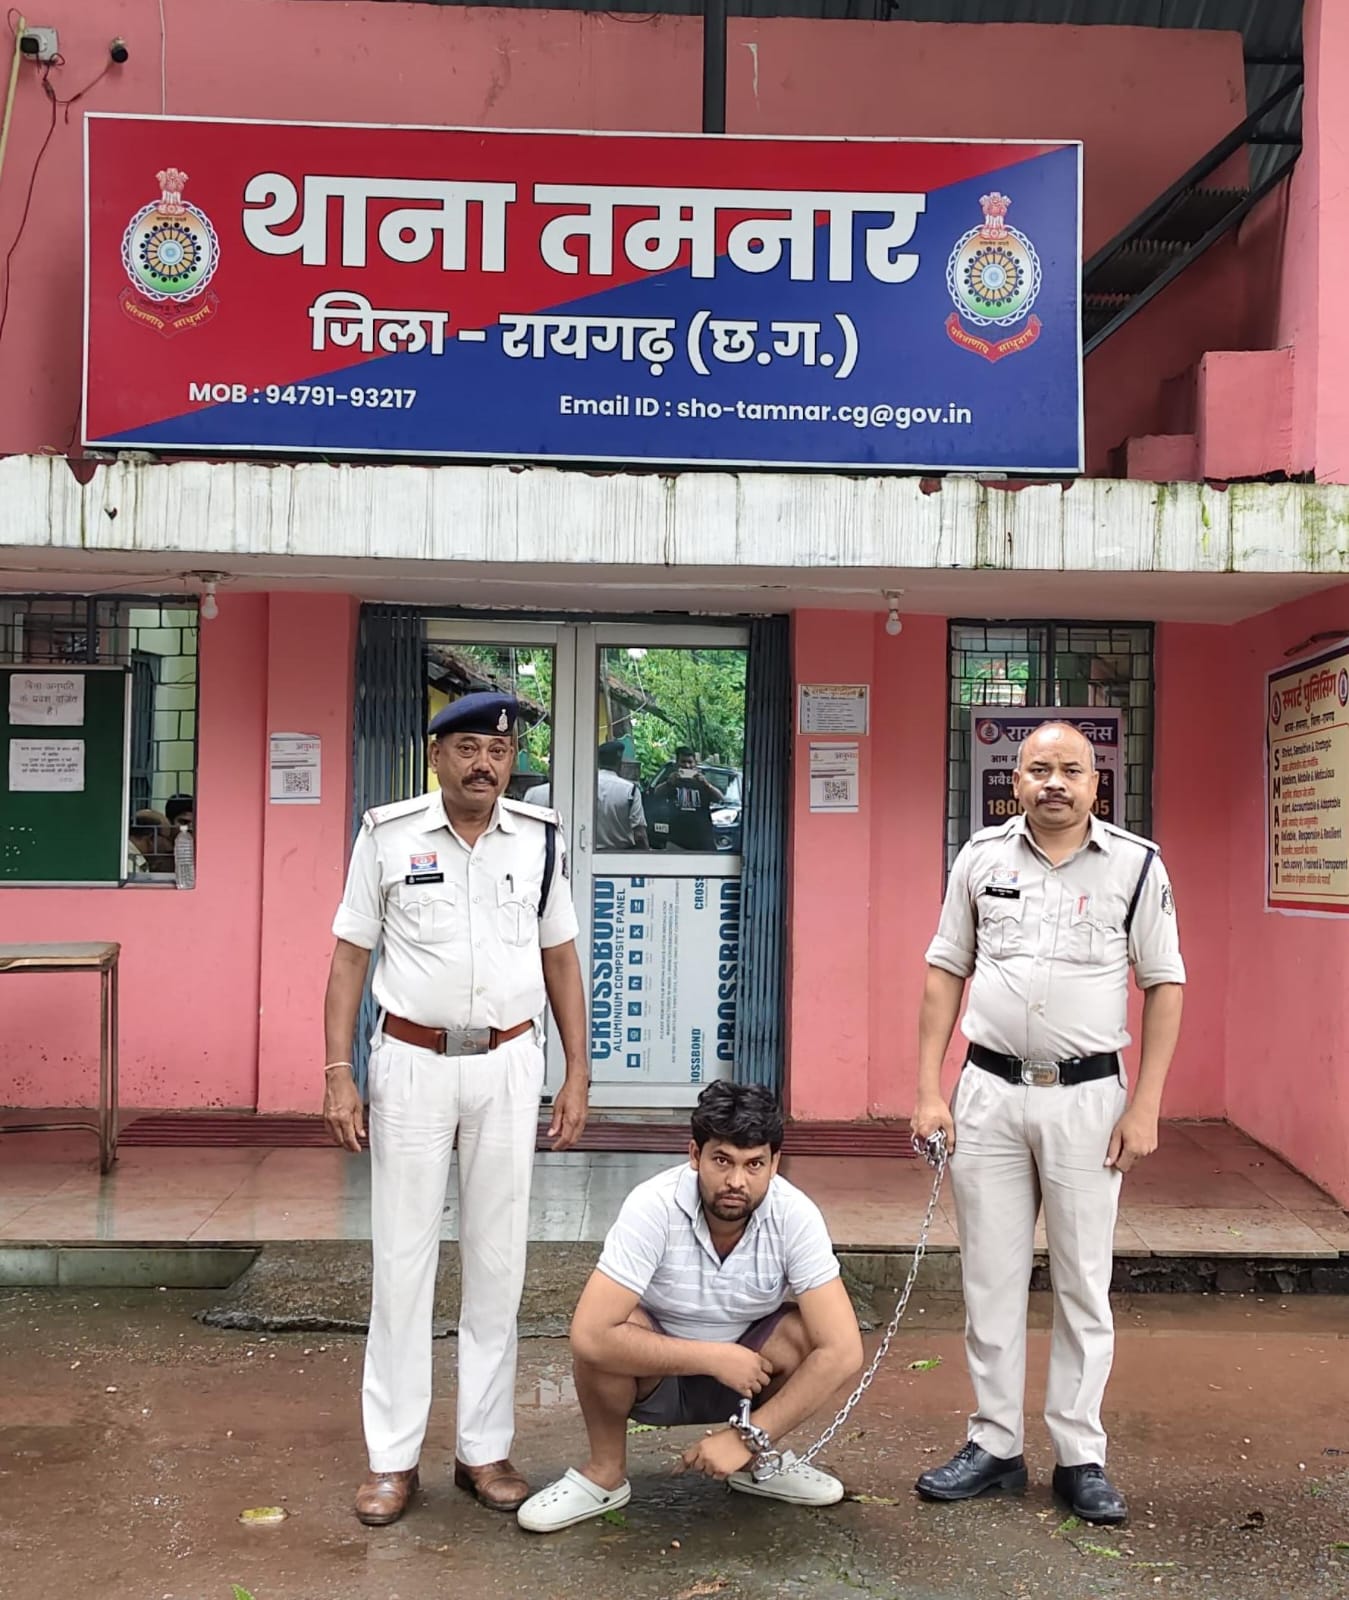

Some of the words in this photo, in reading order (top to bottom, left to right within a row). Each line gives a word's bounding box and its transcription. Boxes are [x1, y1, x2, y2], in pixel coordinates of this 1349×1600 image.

[242, 172, 517, 272] थाना
[533, 182, 927, 284] तमनार
[308, 291, 449, 356] जिला
[499, 313, 676, 377] रायगढ़
[686, 309, 860, 379] (छ.ग.)
[189, 383, 248, 404] MOB
[265, 386, 417, 410] 94791-93217
[559, 395, 629, 417] Email
[635, 397, 660, 417] ID
[677, 398, 972, 429] sho-tamnar.cg@gov.in
[1274, 748, 1280, 771] S
[1273, 776, 1280, 800] M
[1273, 805, 1280, 828] A
[1274, 833, 1280, 857] R
[1274, 862, 1280, 885] T
[616, 888, 626, 923] PANEL
[591, 880, 615, 1061] CROSSBOND
[614, 927, 625, 989] COMPOSITE
[613, 992, 623, 1053] ALUMINIUM
[690, 1028, 701, 1083] ROSSBOND
